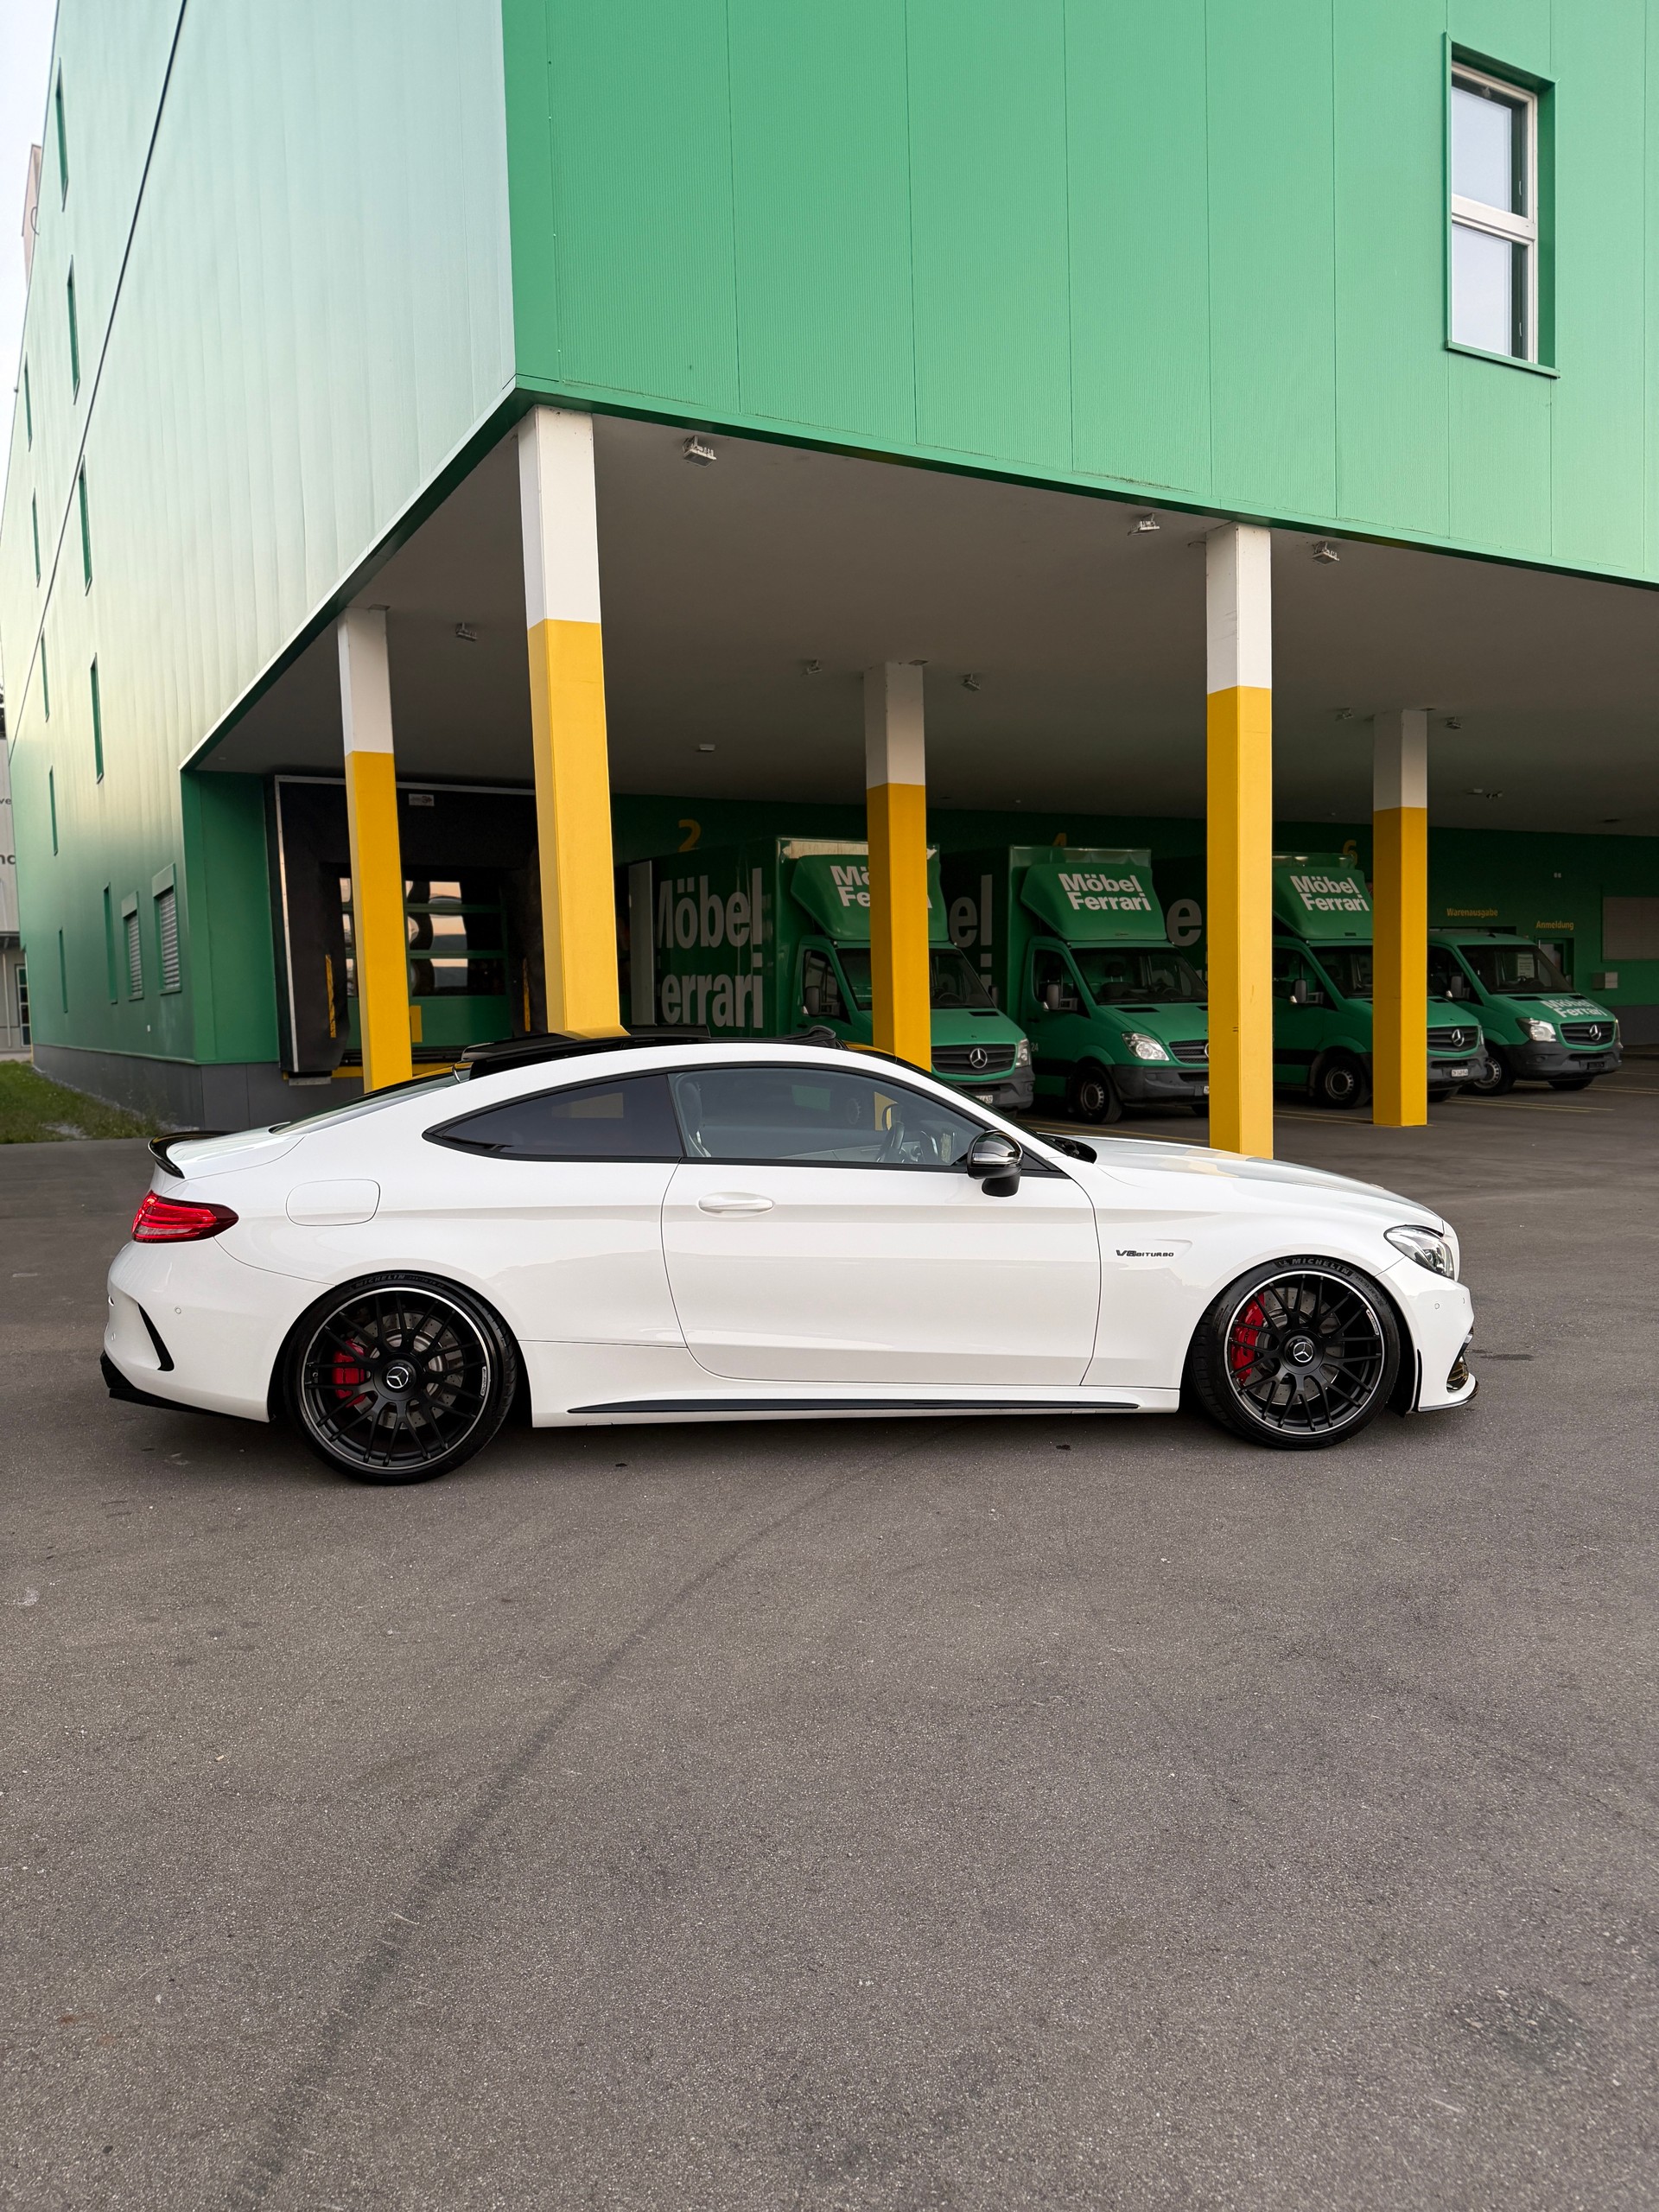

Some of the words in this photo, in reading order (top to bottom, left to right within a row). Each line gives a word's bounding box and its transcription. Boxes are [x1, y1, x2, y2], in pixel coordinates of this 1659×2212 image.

[678, 819, 702, 853] 2
[1058, 874, 1143, 893] Möbel
[1290, 875, 1360, 895] Möbel
[1066, 892, 1152, 912] Ferrari
[1300, 893, 1370, 912] Ferrari
[1446, 907, 1499, 918] Warenausgabe
[1535, 920, 1575, 931] Anmeldung
[657, 953, 764, 1029] errari
[1540, 1000, 1592, 1010] Möbel
[1553, 1007, 1608, 1018] Ferrari
[1291, 1257, 1350, 1275] MICHELIN
[356, 1274, 406, 1287] MICHELIN
